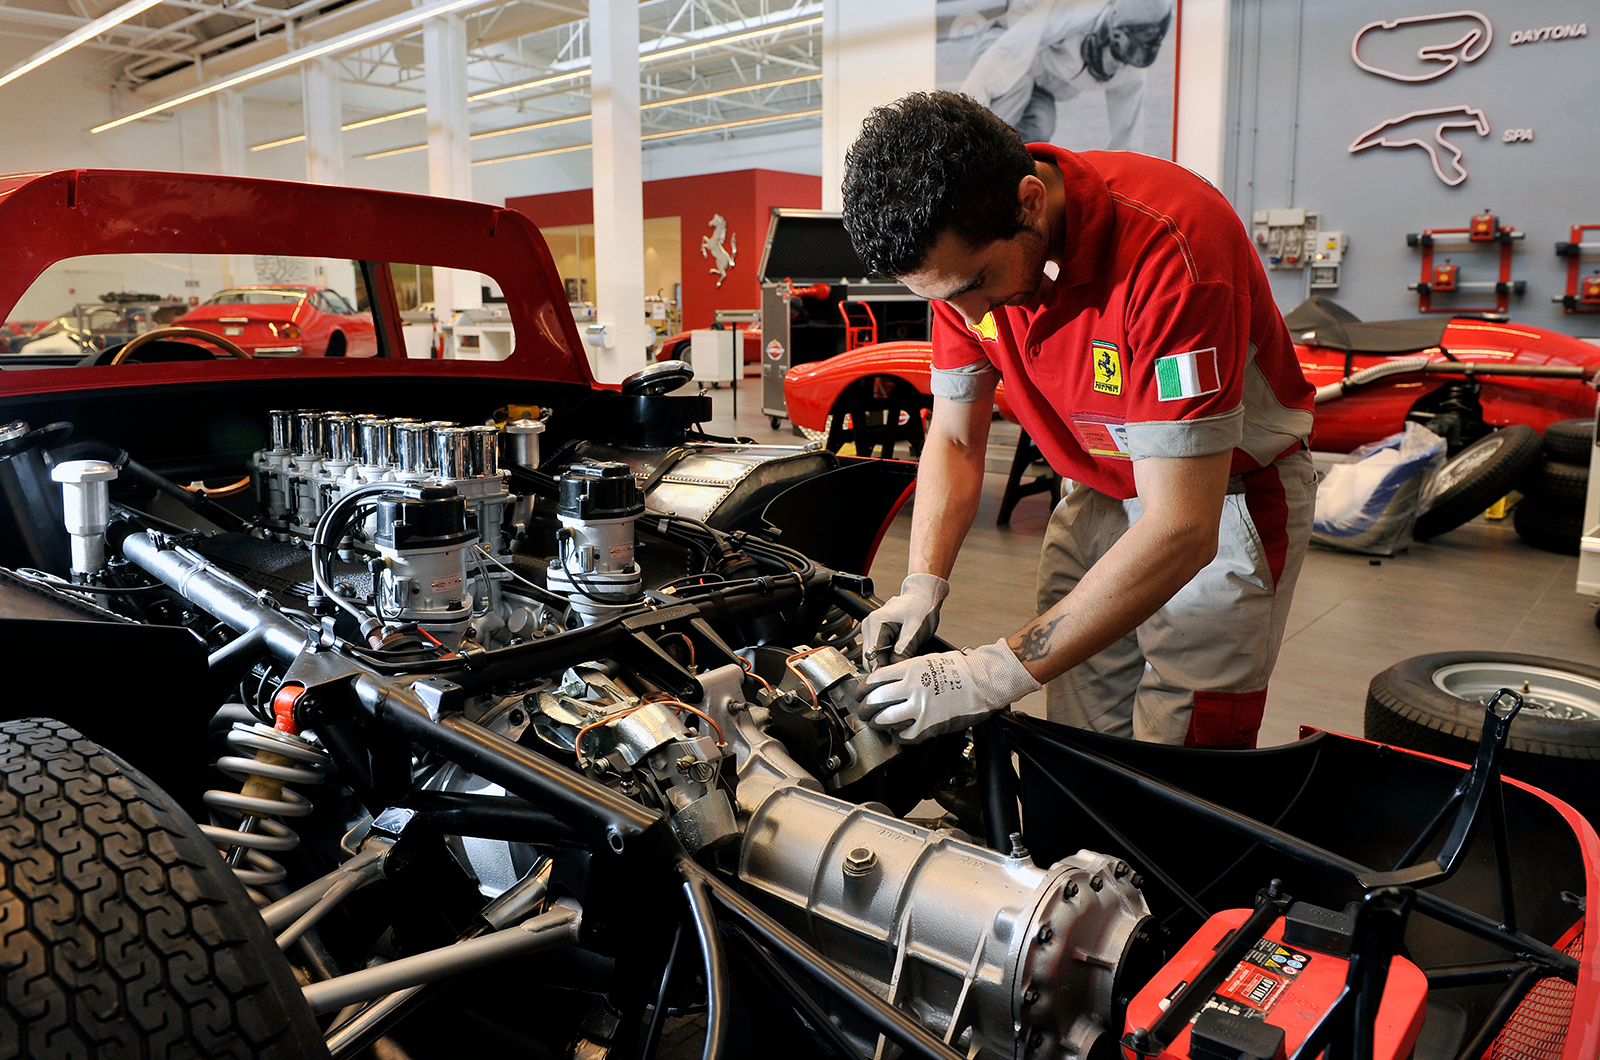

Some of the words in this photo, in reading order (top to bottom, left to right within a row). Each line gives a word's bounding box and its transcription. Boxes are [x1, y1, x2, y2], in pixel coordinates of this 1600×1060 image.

[1509, 22, 1588, 45] DAYTONA
[1502, 127, 1534, 143] SPA
[926, 659, 940, 695] Mangold
[1249, 977, 1275, 1001] OPTIMA
